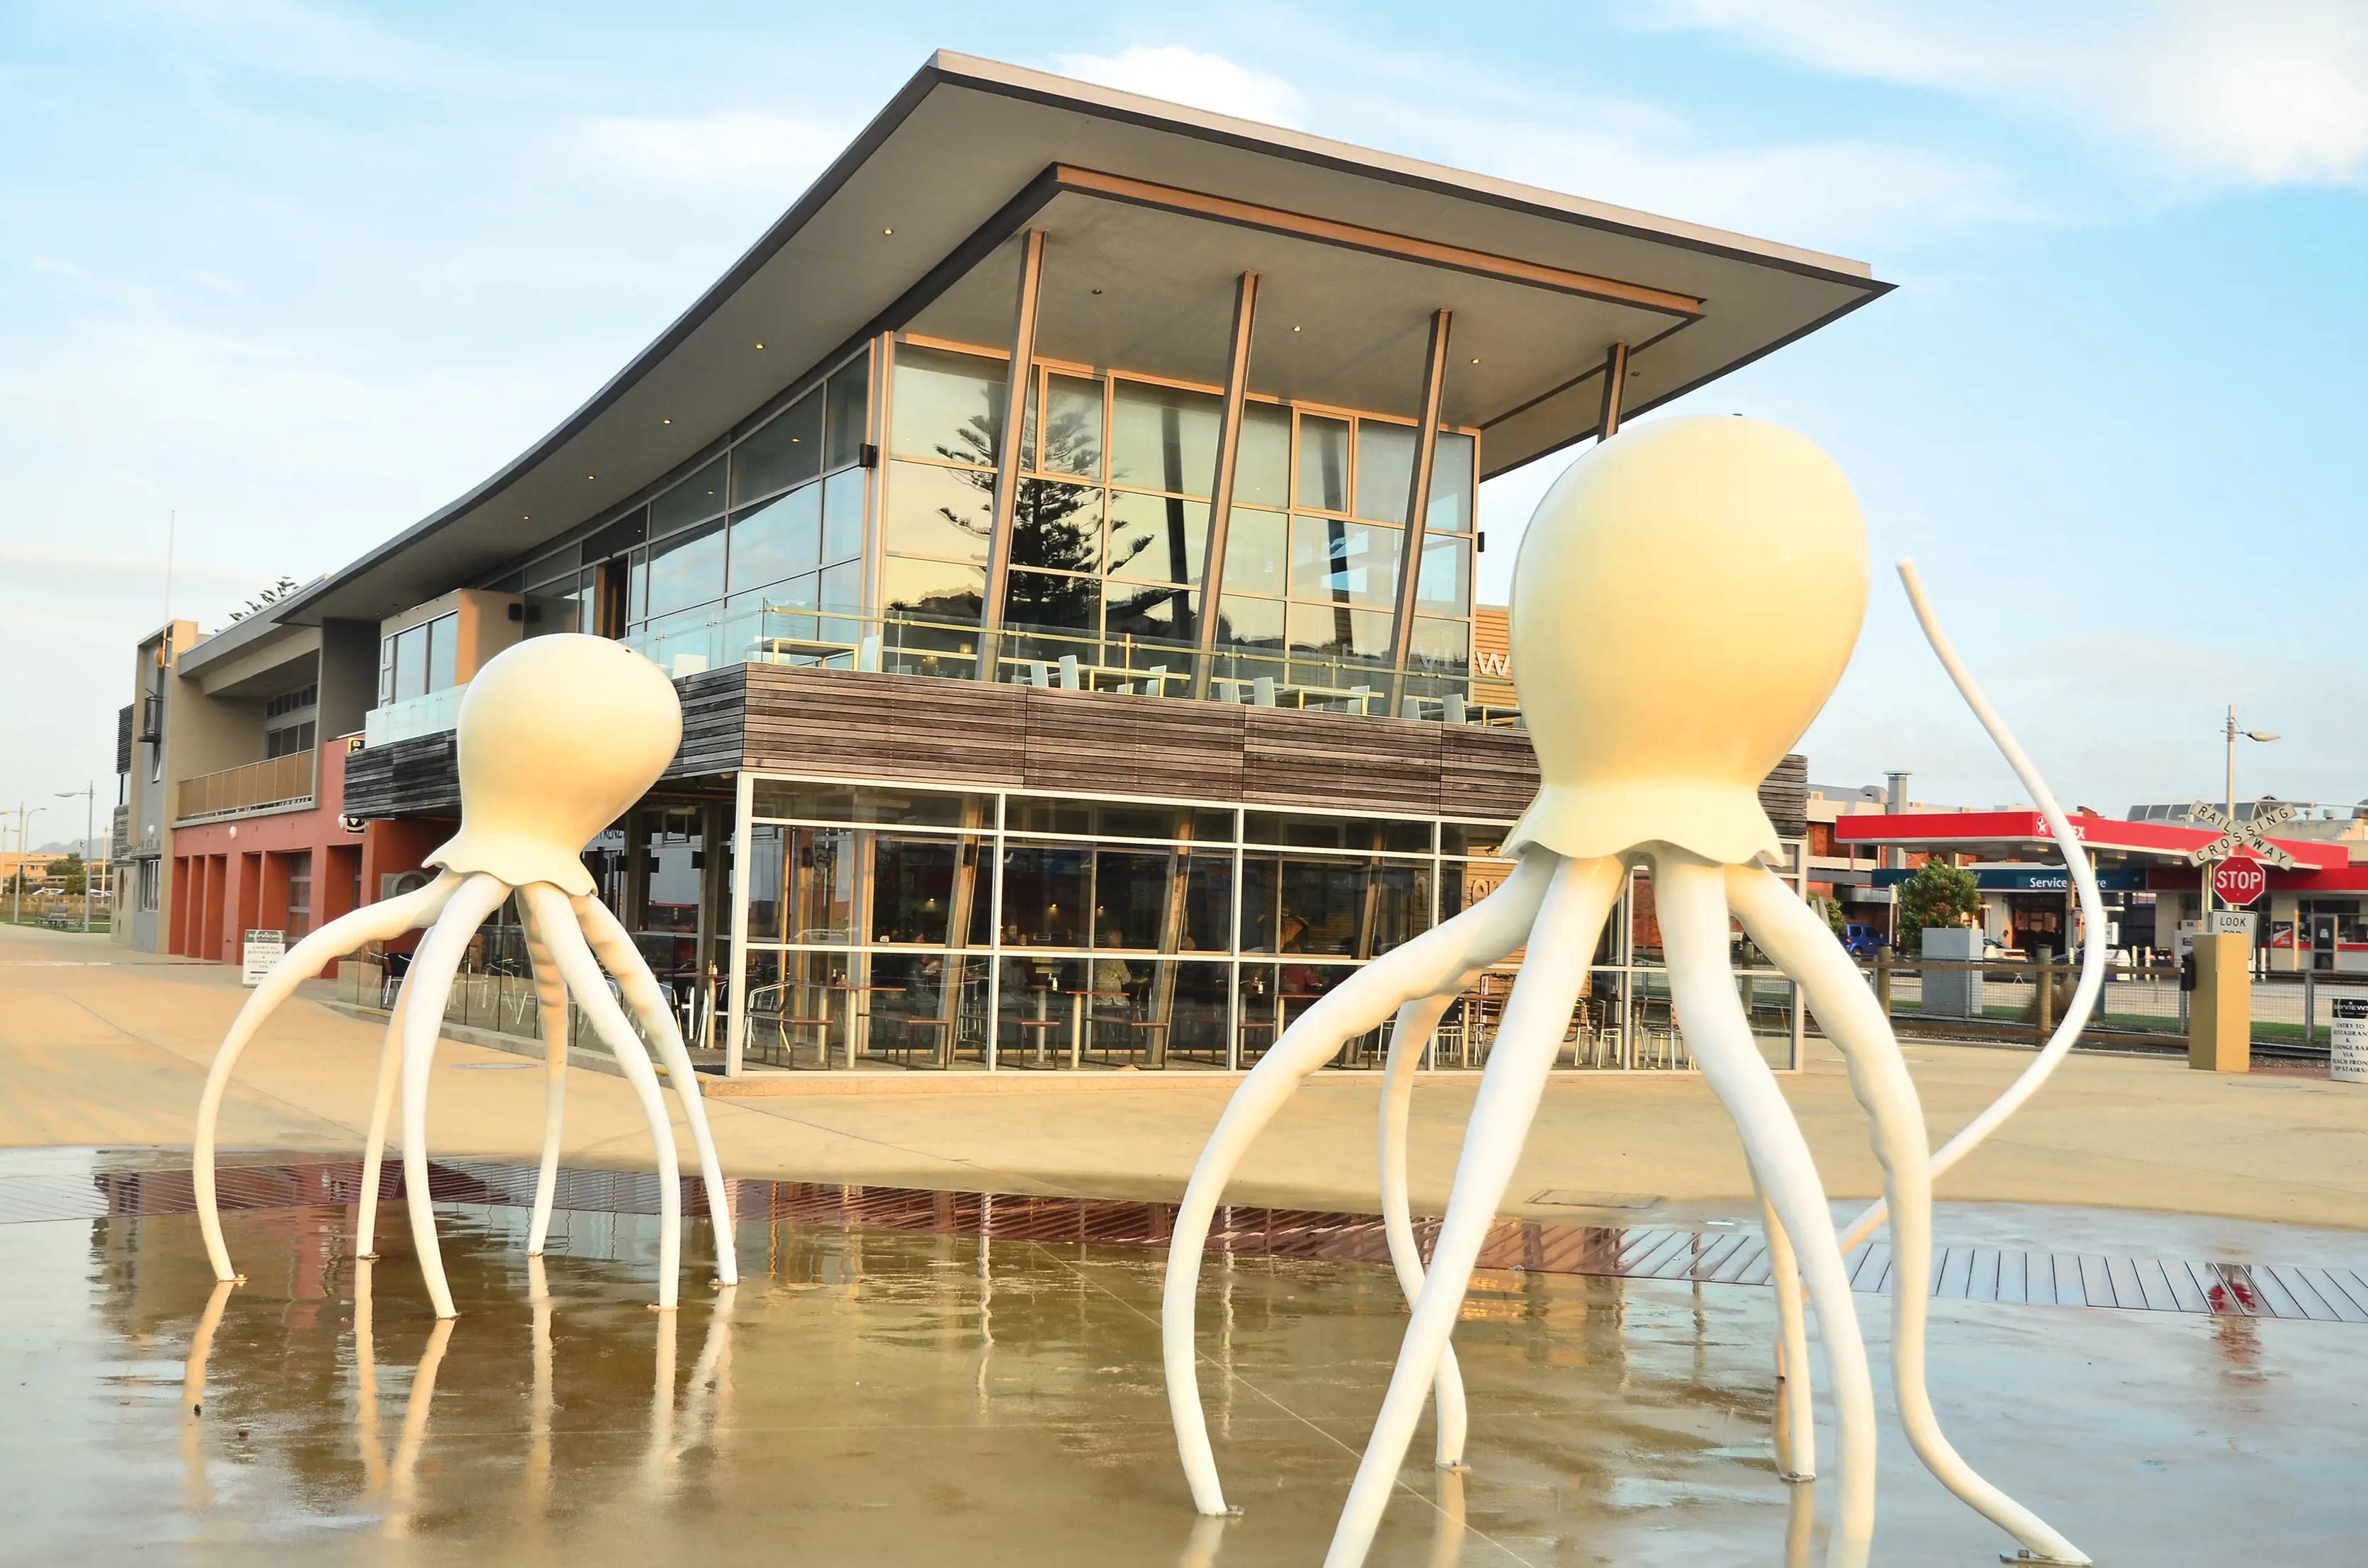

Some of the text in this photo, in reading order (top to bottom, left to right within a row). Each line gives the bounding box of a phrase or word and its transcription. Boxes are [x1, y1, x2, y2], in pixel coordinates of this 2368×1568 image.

[2197, 808, 2288, 862] CROSSING
[2198, 806, 2287, 863] RAIL WAY
[2029, 877, 2067, 888] Service
[2216, 870, 2261, 889] STOP
[2220, 917, 2246, 927] LOOK
